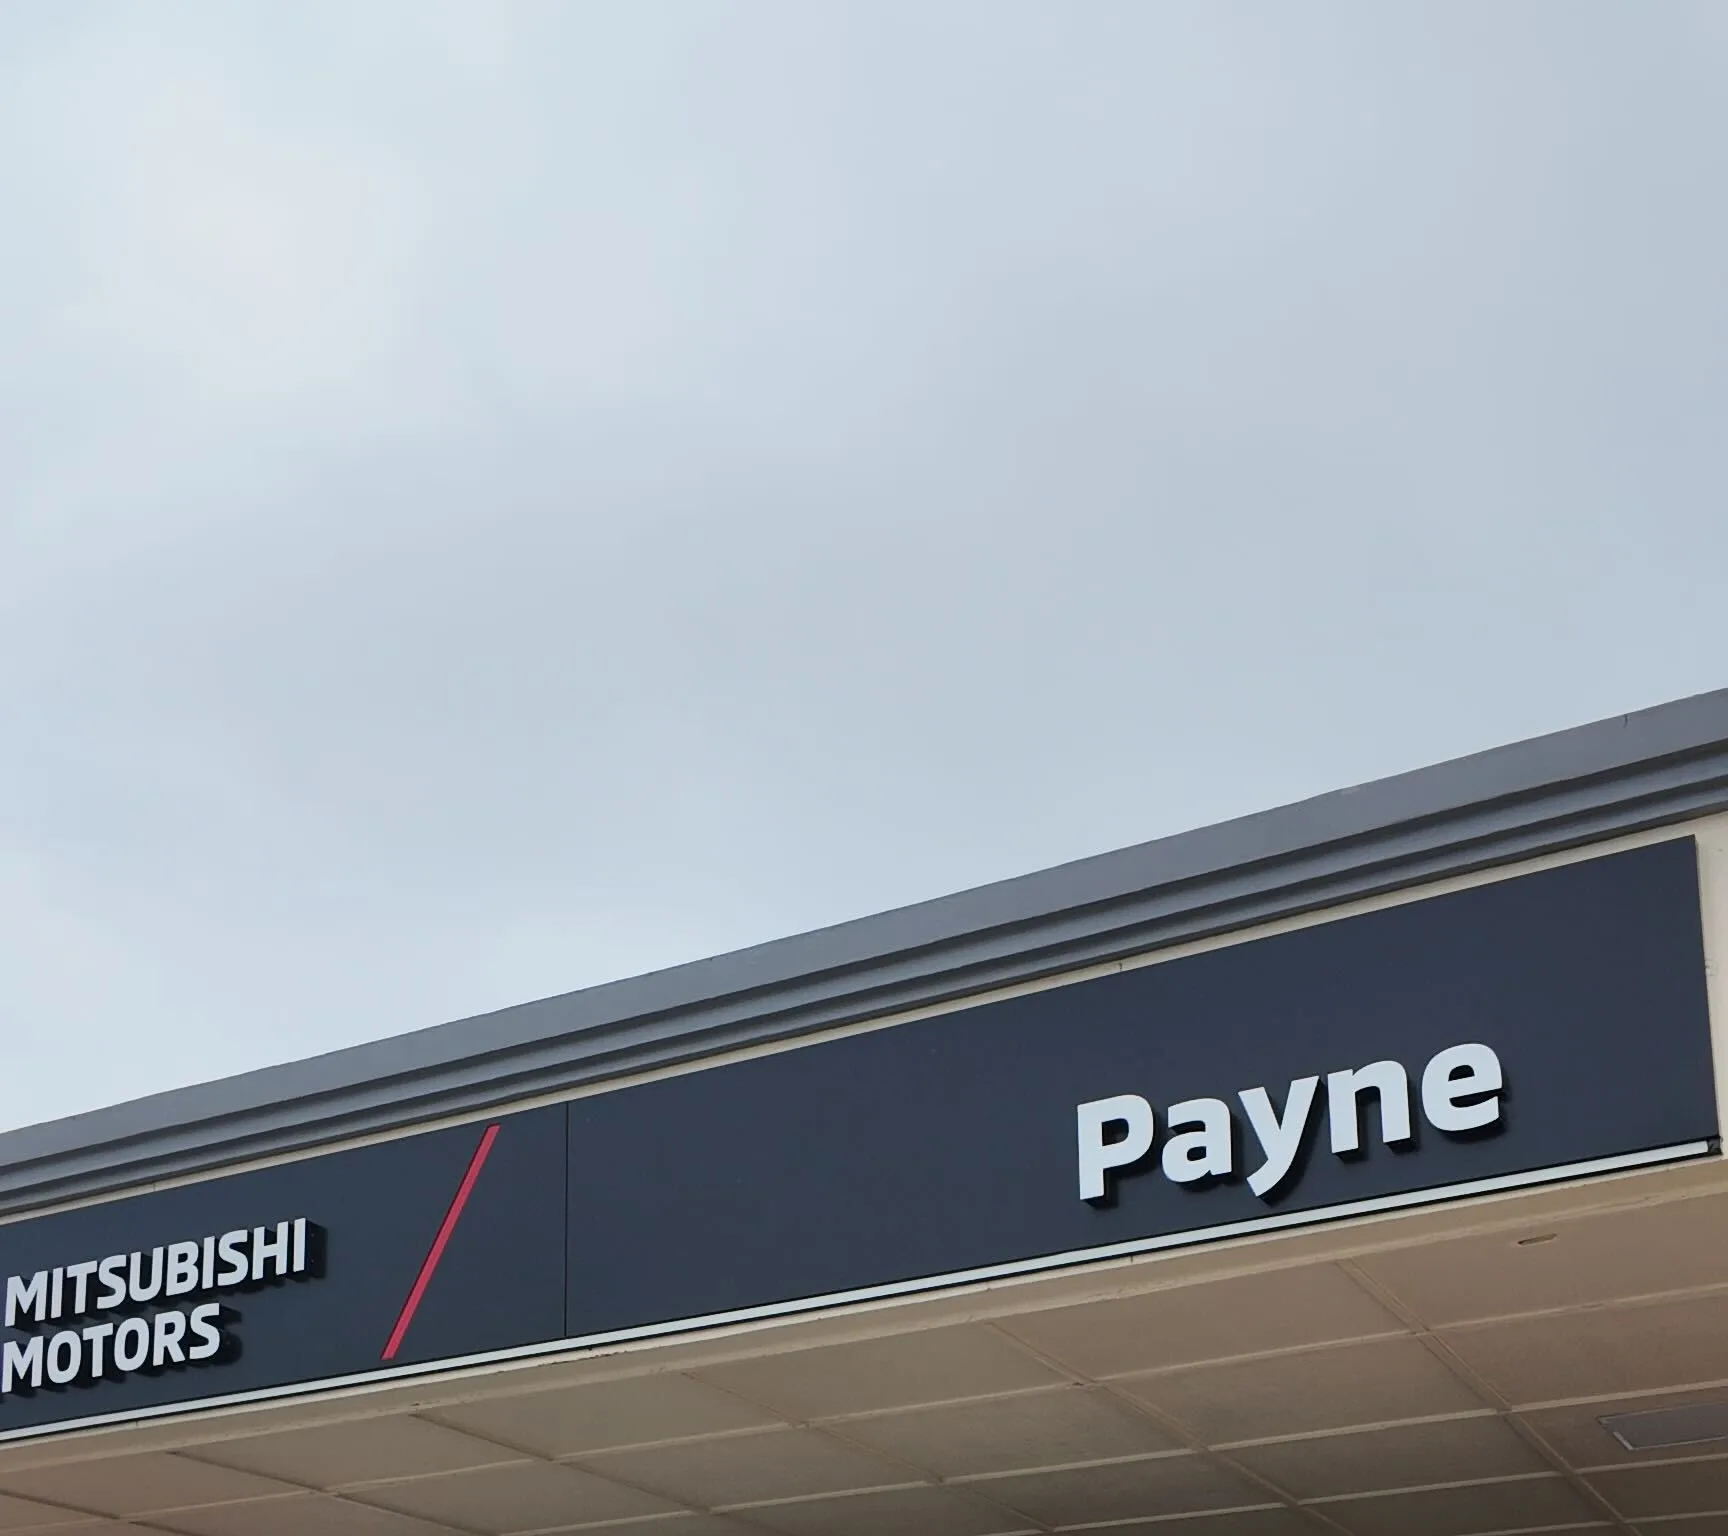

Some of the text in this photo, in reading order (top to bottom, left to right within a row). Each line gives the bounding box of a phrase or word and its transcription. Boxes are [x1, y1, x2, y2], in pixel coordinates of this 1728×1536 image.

[1077, 1043, 1503, 1200] Payne
[4, 1217, 307, 1327] MITSUBISHI
[1, 1303, 220, 1393] MOTORS
